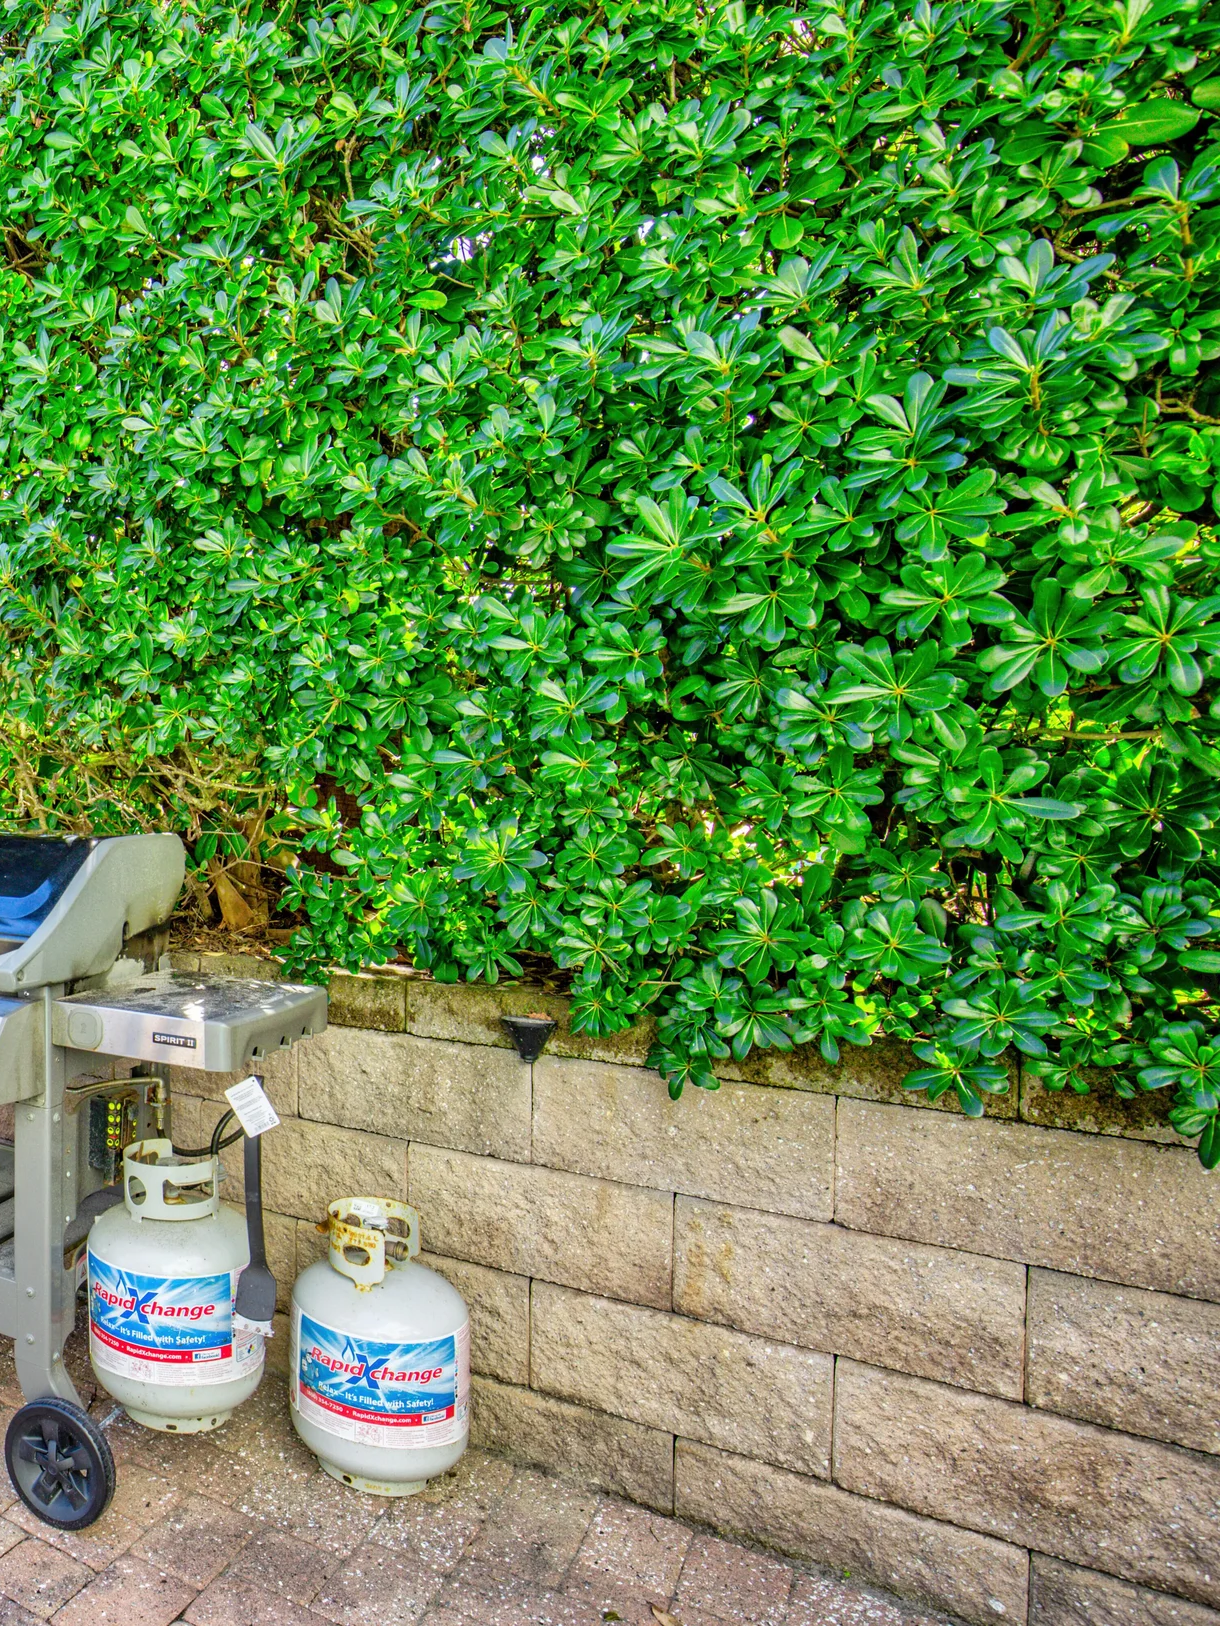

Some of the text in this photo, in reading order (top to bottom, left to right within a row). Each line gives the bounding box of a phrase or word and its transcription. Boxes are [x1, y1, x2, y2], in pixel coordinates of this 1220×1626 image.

[154, 1035, 194, 1047] SPIRIT II
[120, 1326, 131, 1336] It's
[132, 1329, 153, 1341] Filled
[154, 1336, 174, 1344] with
[176, 1335, 206, 1345] Safety!
[126, 1345, 182, 1360] RapidXchange.com
[345, 1392, 358, 1402] It's
[359, 1395, 382, 1406] Filled
[384, 1400, 405, 1408] with
[406, 1398, 434, 1408] Safety!
[352, 1410, 412, 1423] RapidXchange.com
